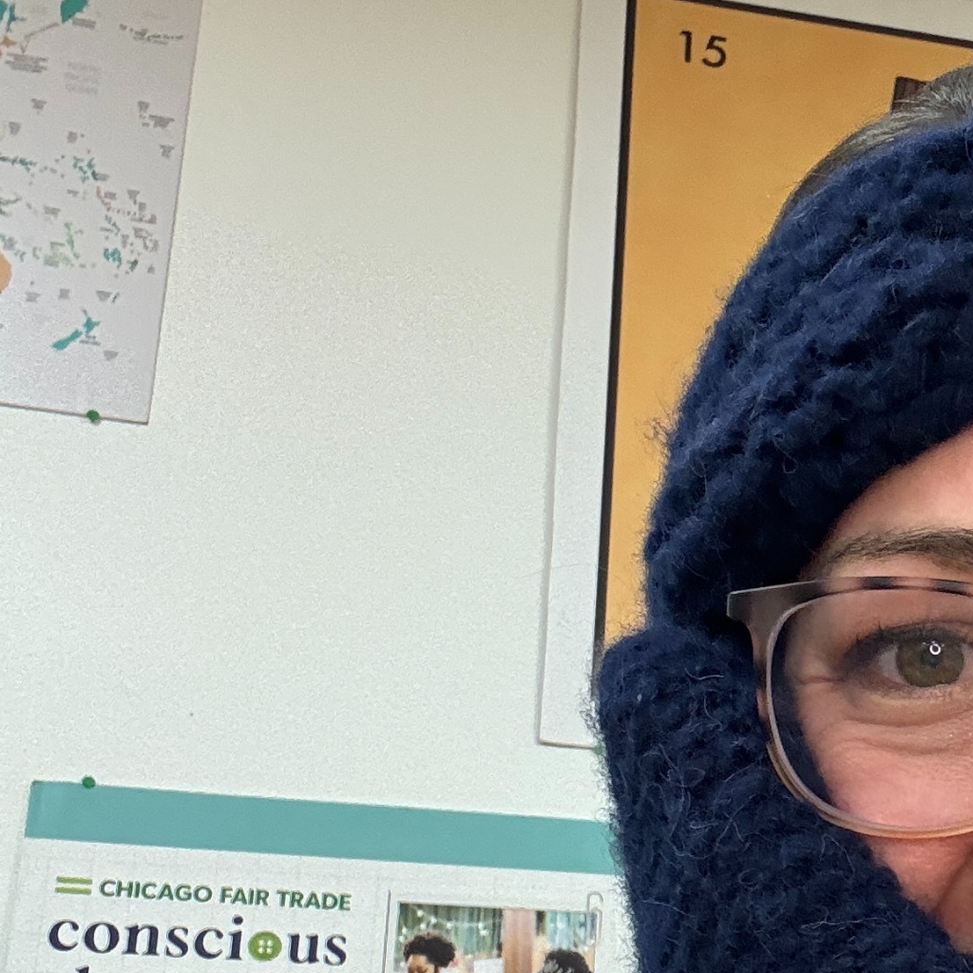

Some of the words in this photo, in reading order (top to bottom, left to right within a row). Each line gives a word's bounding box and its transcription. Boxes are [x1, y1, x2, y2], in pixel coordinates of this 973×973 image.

[680, 30, 727, 67] 15
[99, 879, 213, 904] CHICAGO
[219, 885, 270, 906] FAIR
[276, 888, 352, 911] TRADE
[48, 914, 347, 966] conscious
